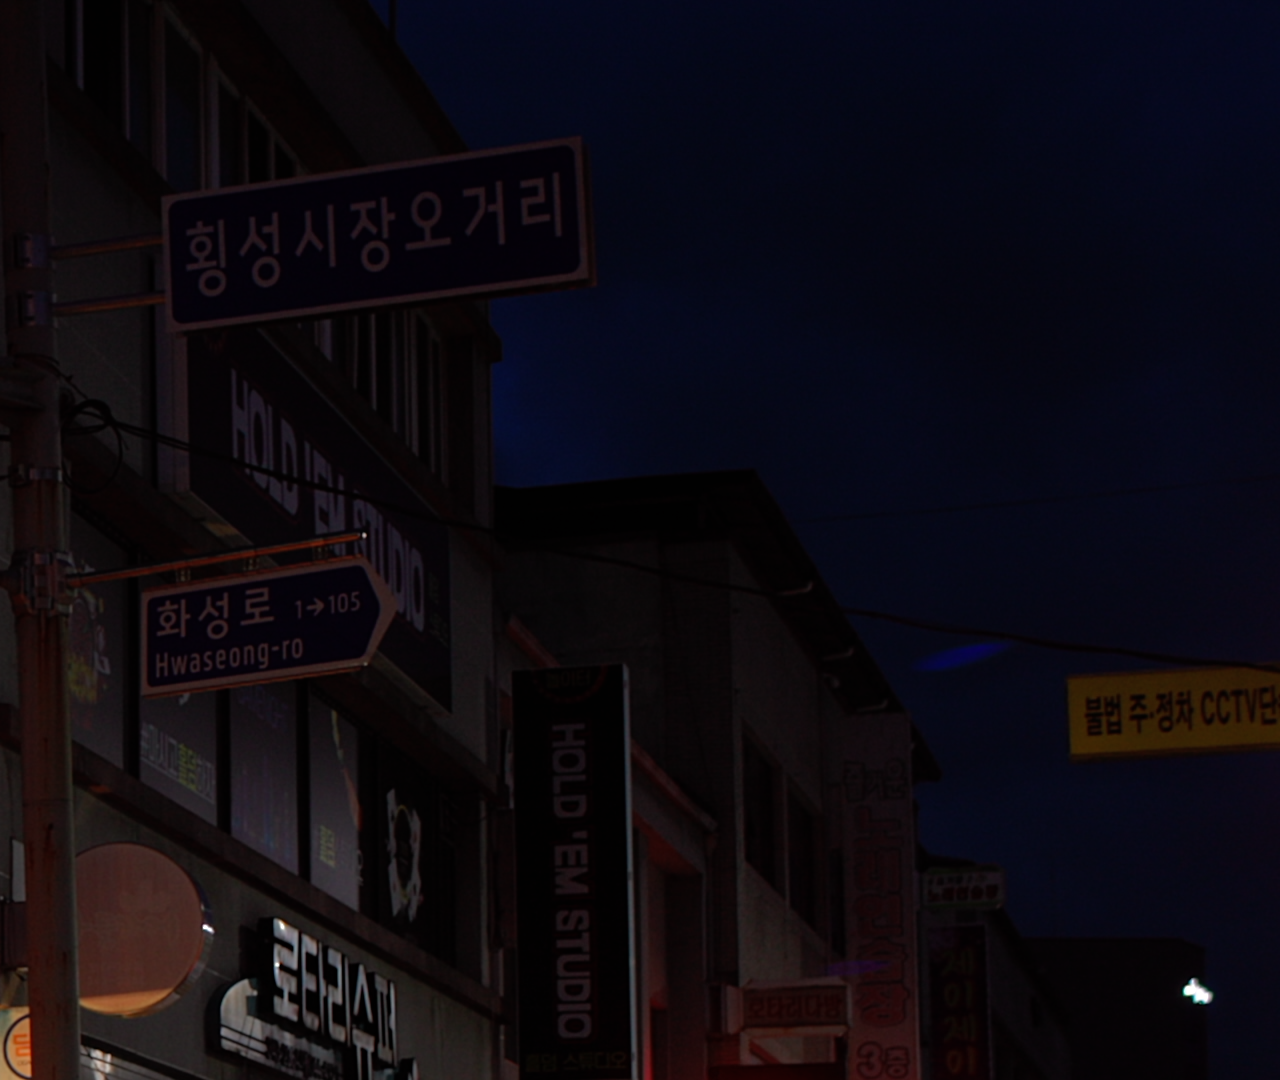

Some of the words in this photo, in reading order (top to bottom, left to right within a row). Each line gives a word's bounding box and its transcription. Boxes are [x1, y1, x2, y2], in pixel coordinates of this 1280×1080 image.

[184, 171, 564, 298] 횡성시장오거리
[230, 367, 299, 517] HOLD
[352, 490, 425, 633] STUDIO
[154, 637, 305, 679] Hwaseong-ro
[155, 586, 276, 641] 화성로
[1085, 693, 1123, 737] 불법
[1200, 684, 1280, 726] CCTV단
[550, 722, 588, 820] HOLD
[554, 908, 593, 1040] STUDIO
